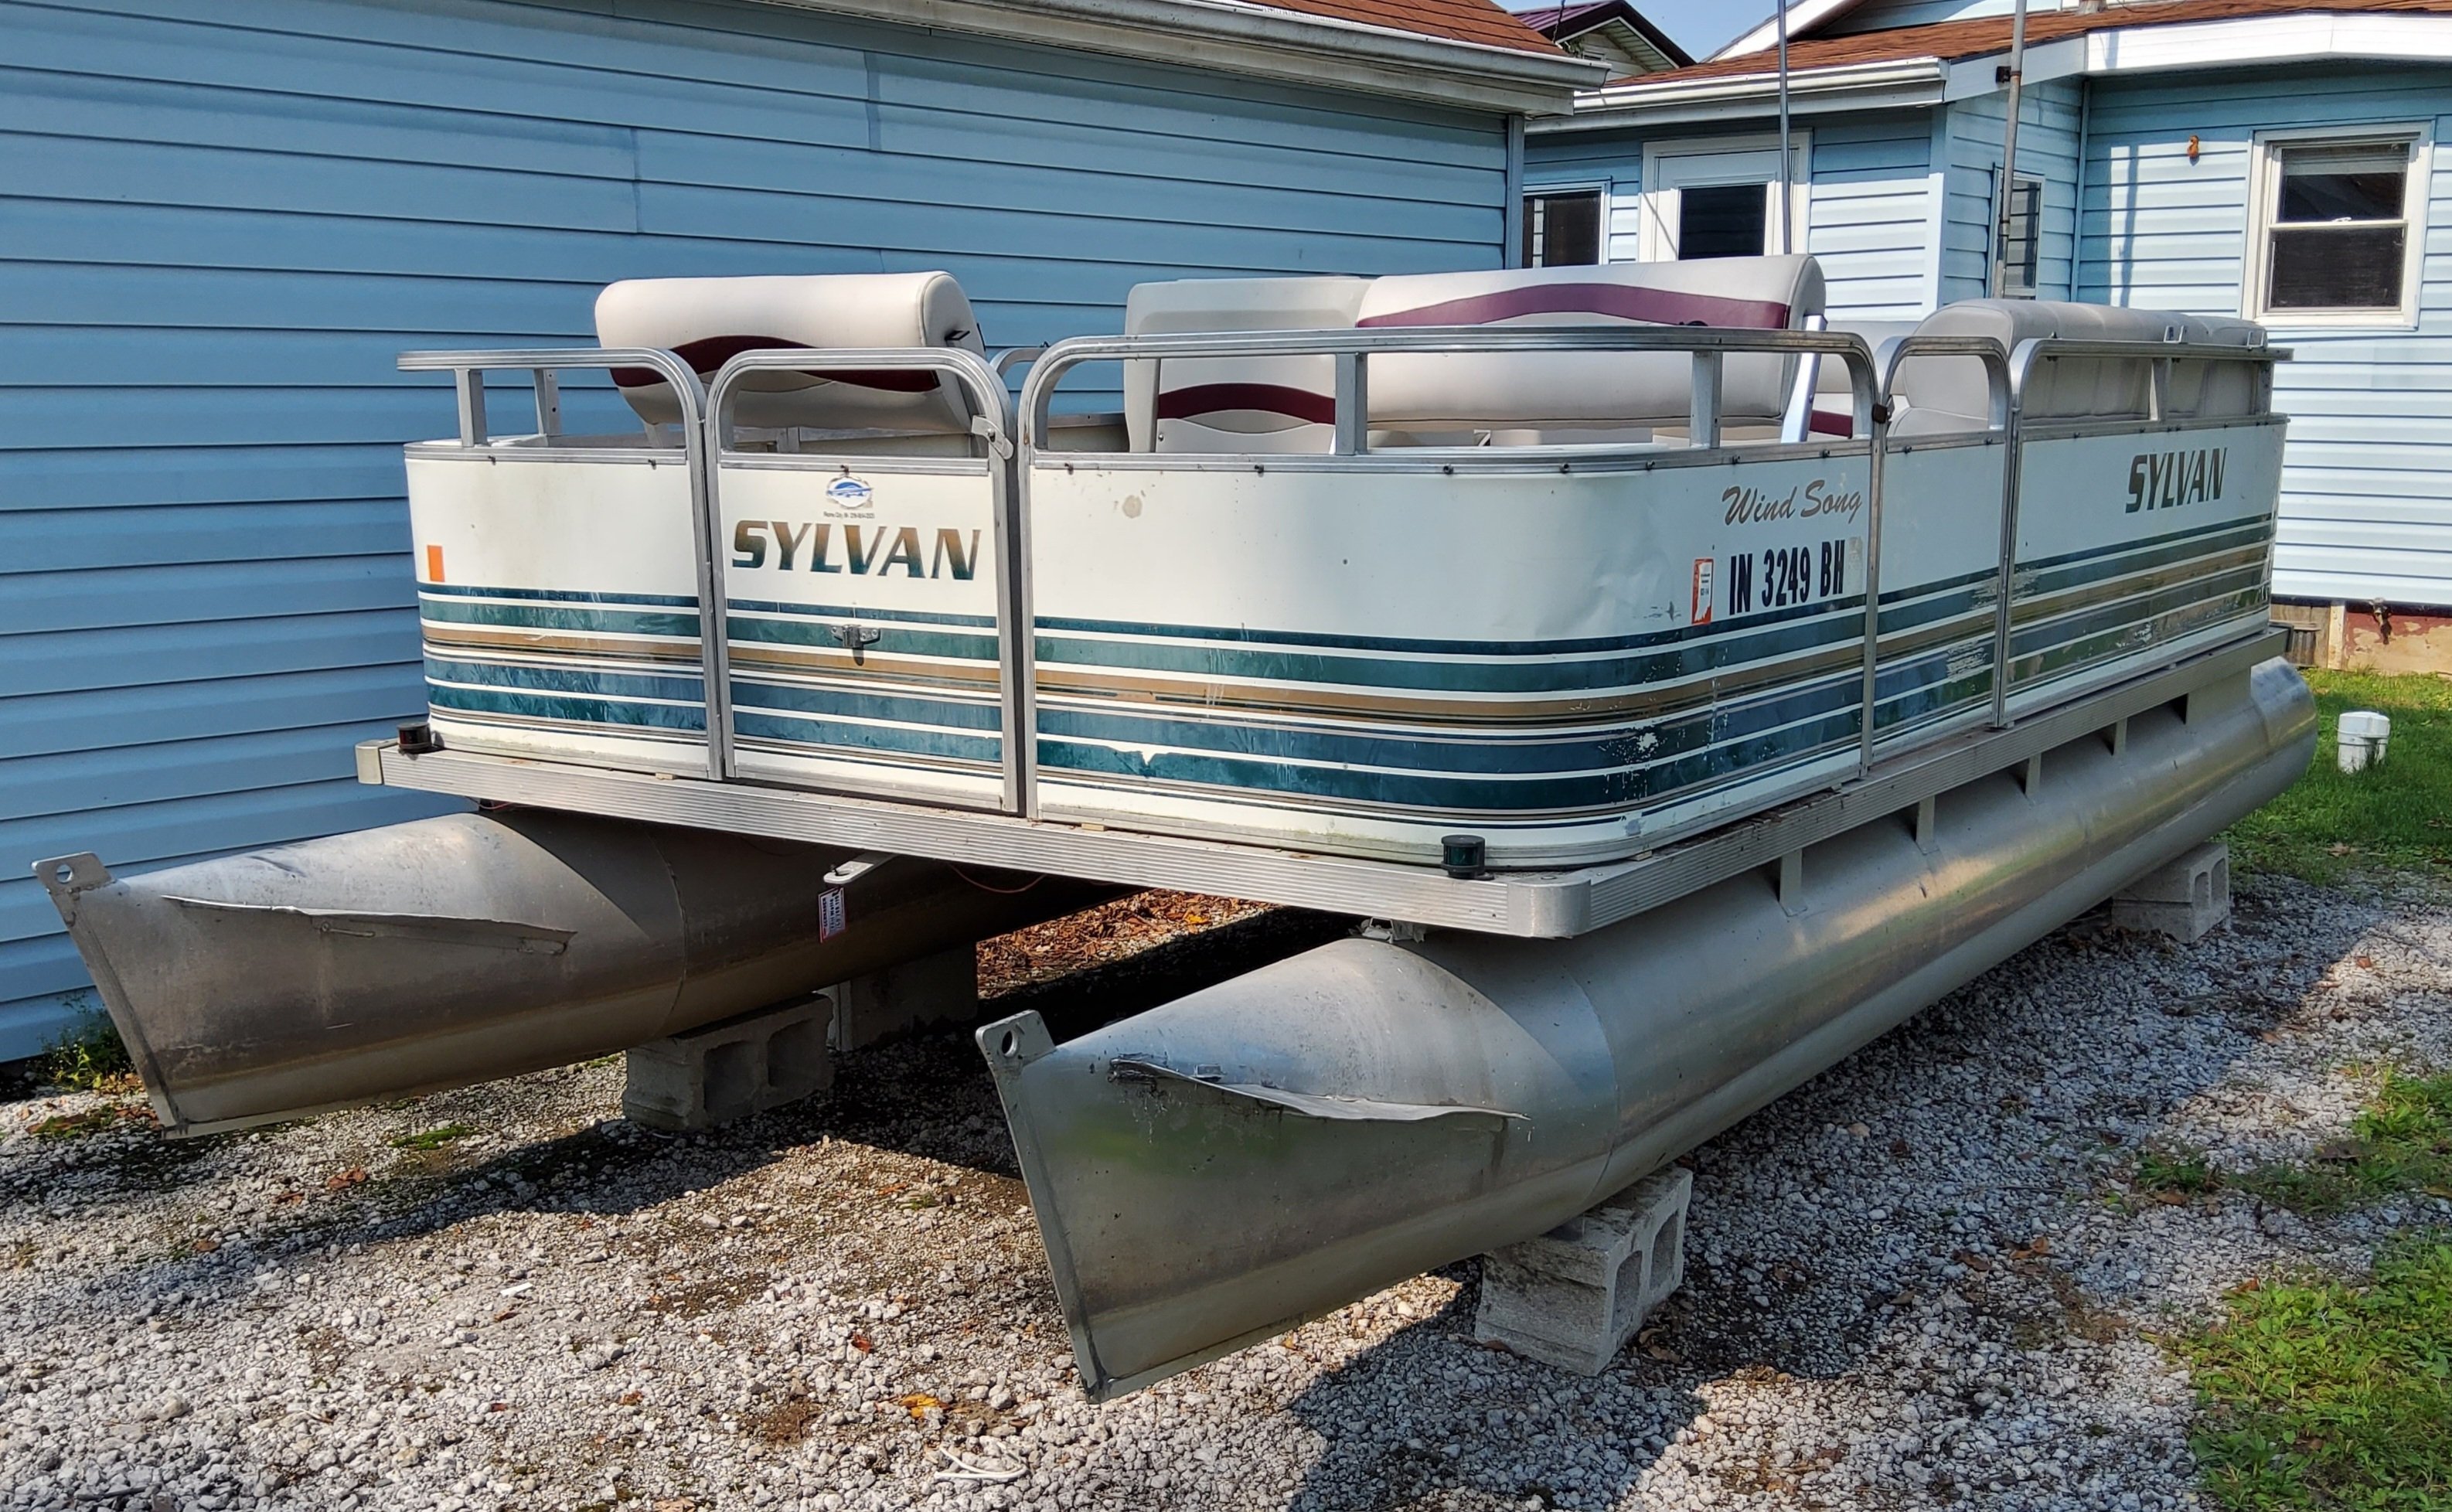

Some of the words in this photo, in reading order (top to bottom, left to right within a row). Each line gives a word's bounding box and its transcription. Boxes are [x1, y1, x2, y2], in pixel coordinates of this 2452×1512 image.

[1722, 485, 1797, 526] Wind
[1800, 479, 1862, 524] Song
[2125, 447, 2228, 514] SYLVAN
[731, 519, 982, 581] SYLVAN
[1729, 553, 1753, 615] IN
[1761, 546, 1811, 608] 3249
[1820, 540, 1846, 598] BH
